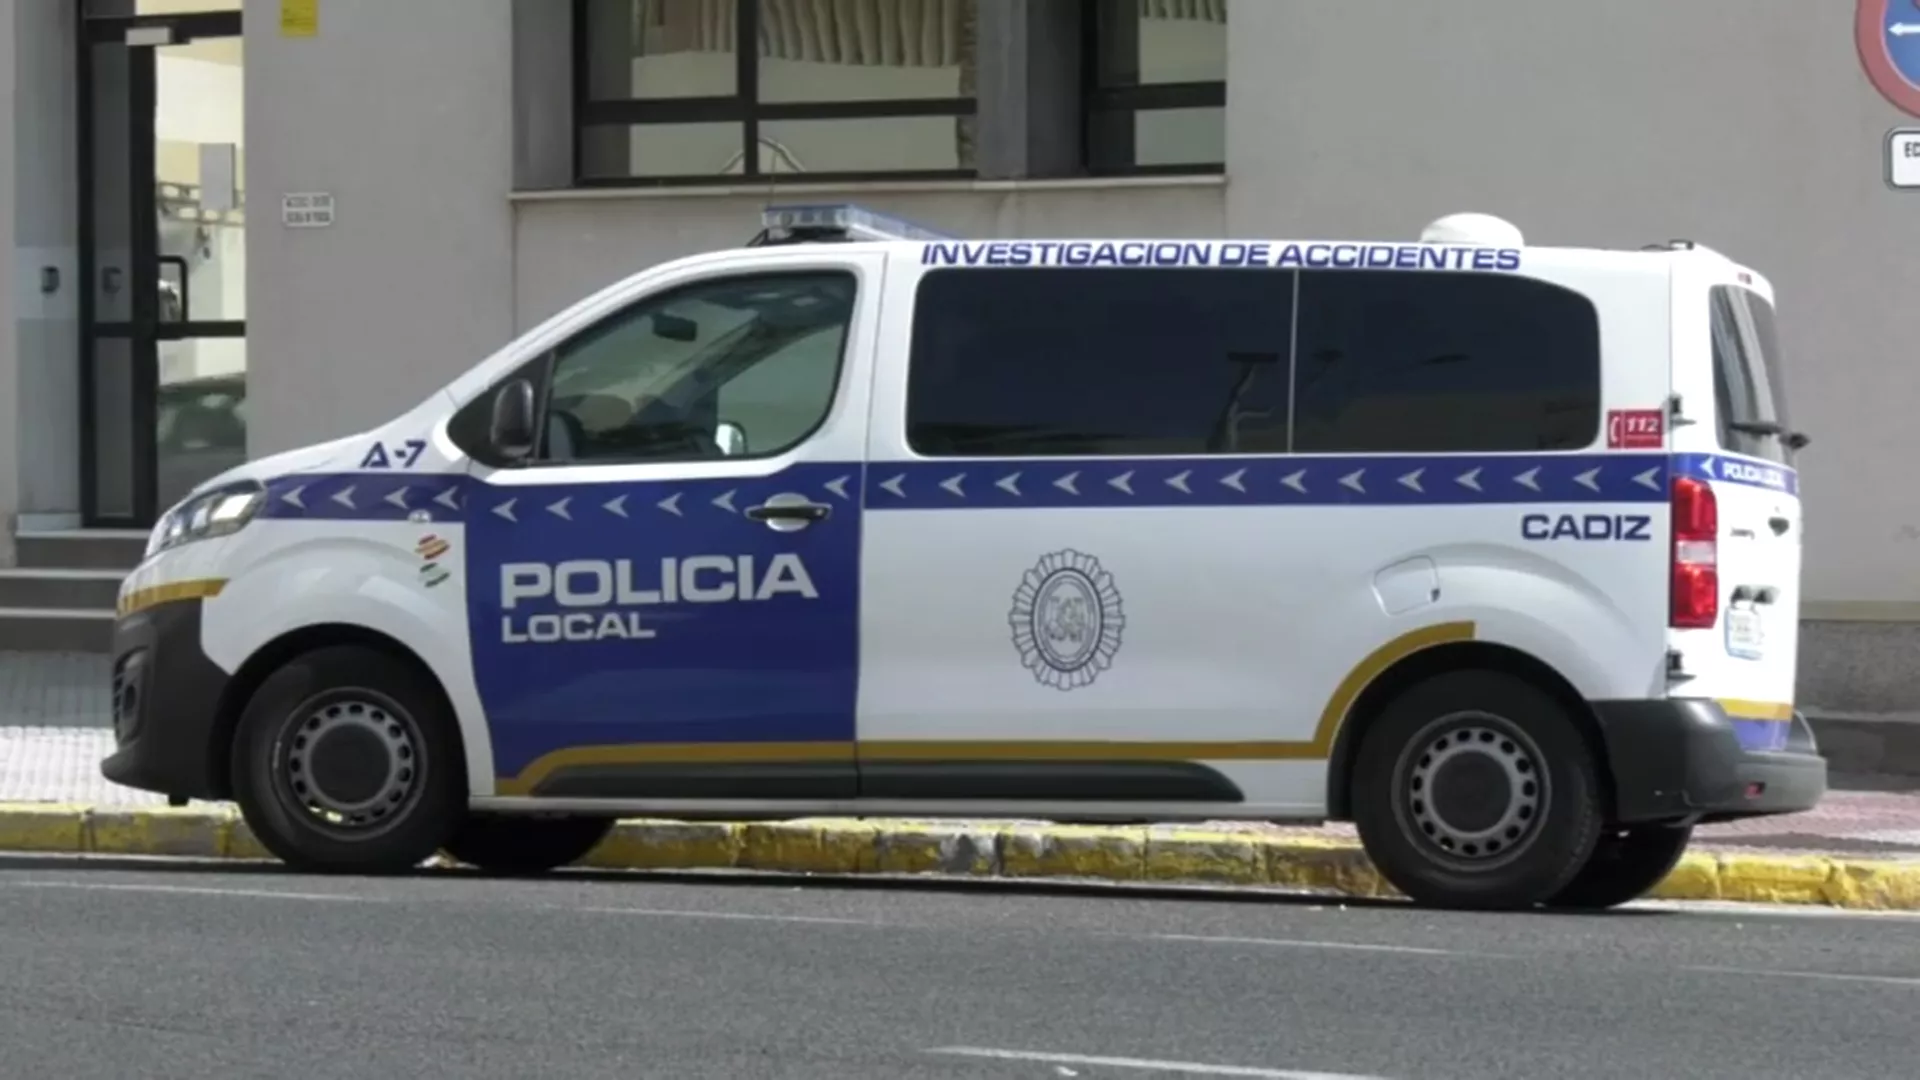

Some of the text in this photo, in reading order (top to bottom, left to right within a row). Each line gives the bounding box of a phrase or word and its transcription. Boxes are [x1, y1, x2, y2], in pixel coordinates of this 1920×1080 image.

[921, 243, 1520, 270] INVESTIGACION DE ACCIDENTES
[1627, 416, 1659, 432] 112
[360, 440, 427, 468] A-7
[1521, 514, 1652, 540] CADIZ
[500, 553, 819, 608] POLICIA
[502, 612, 656, 643] LOCAL
